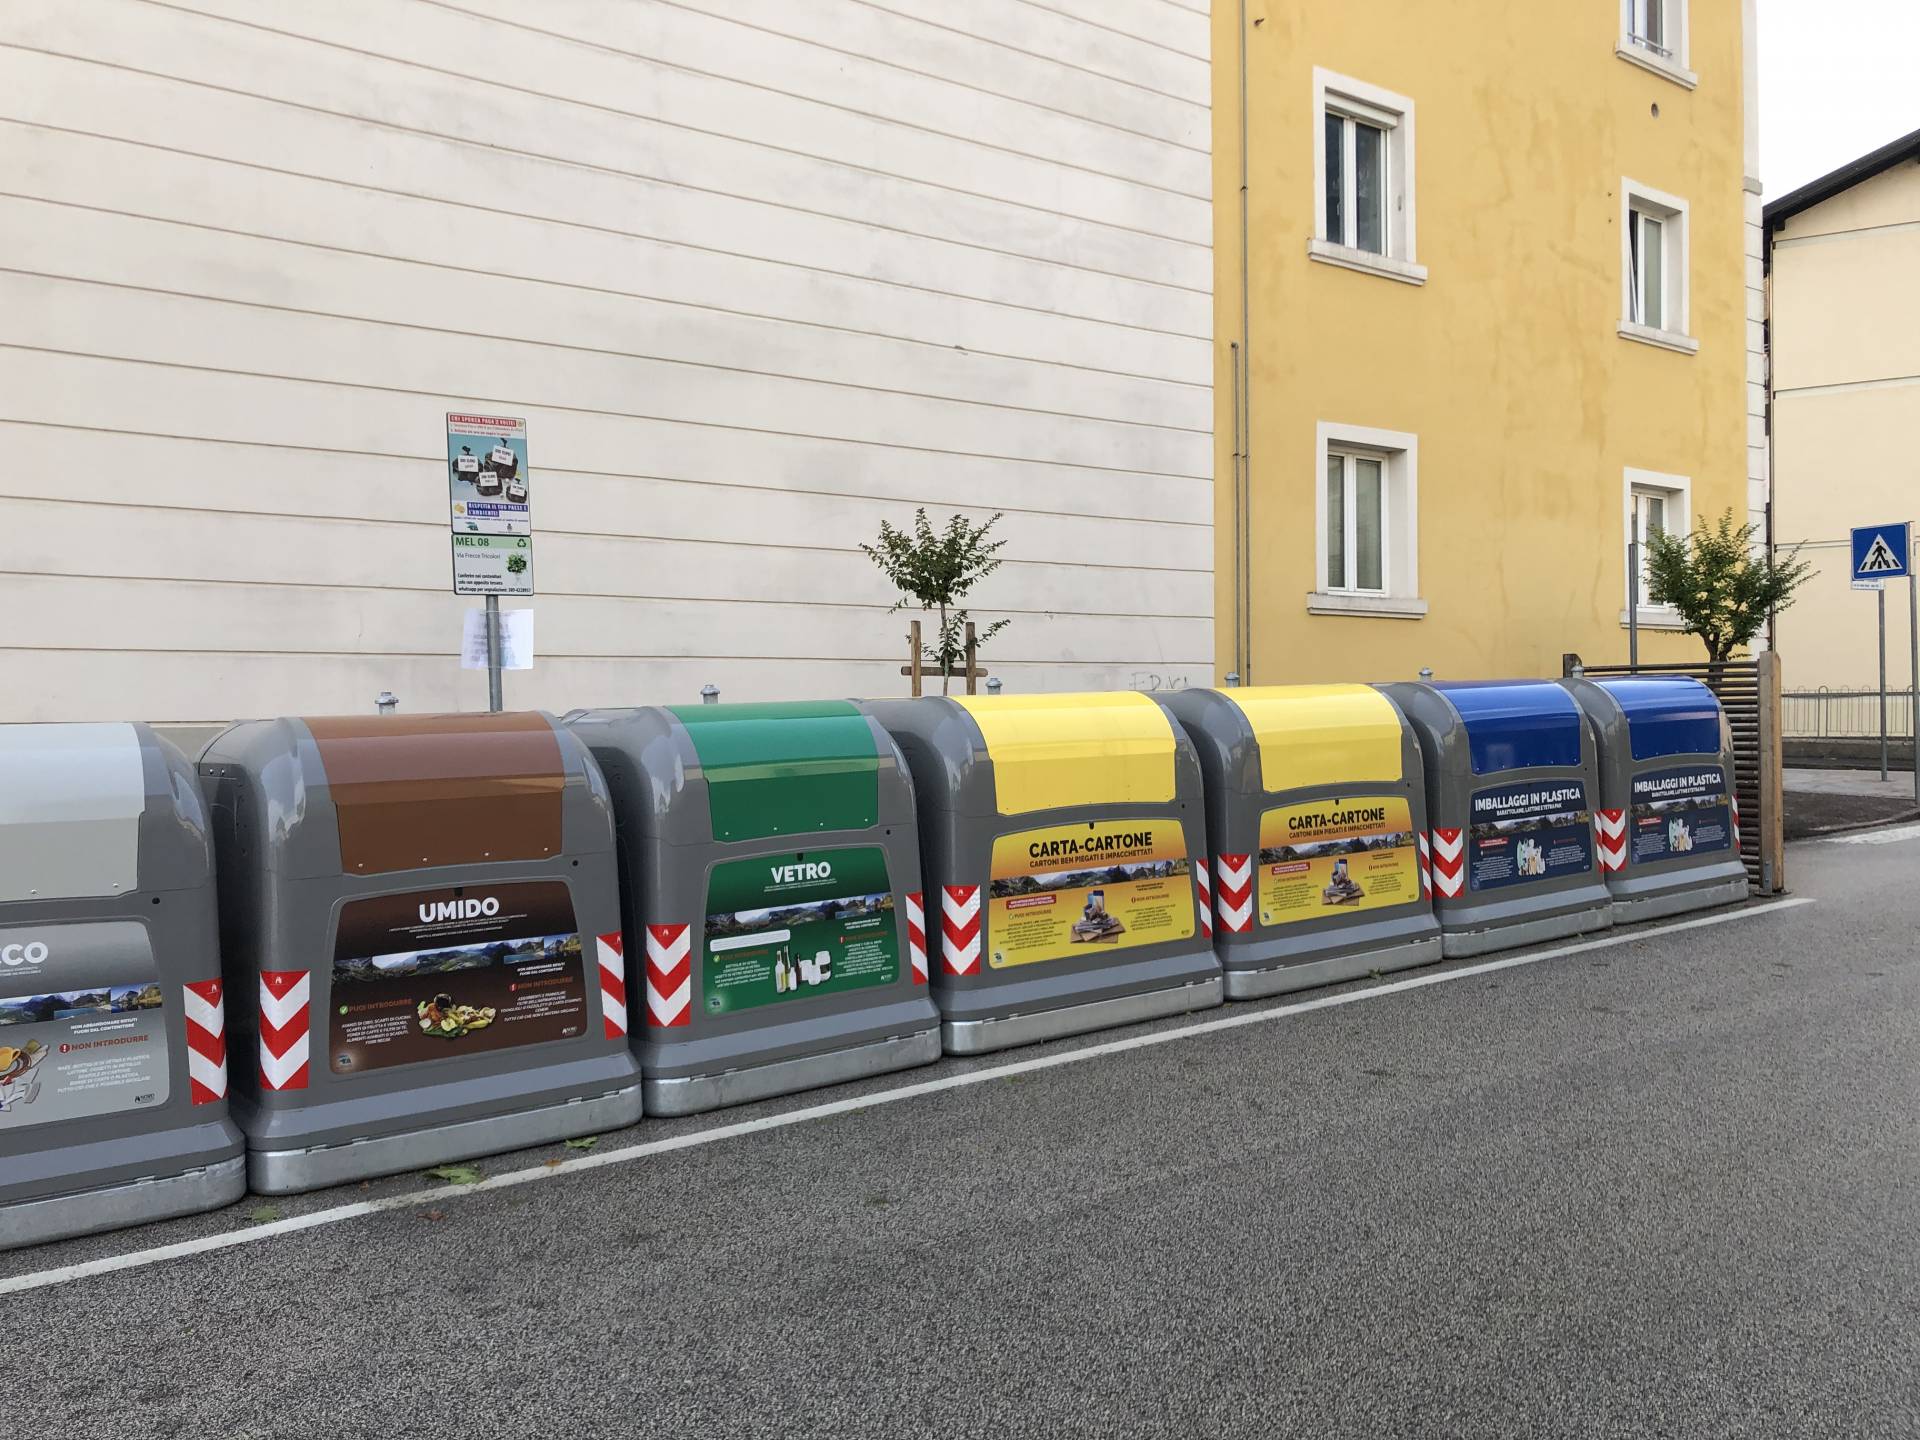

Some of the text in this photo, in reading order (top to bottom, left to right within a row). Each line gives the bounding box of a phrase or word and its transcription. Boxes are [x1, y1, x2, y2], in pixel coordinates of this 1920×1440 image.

[456, 537, 489, 546] MEL 08
[1635, 773, 1721, 792] IMBALLAGGI IN PLASTICA
[1475, 787, 1581, 811] IMBALLAGGI IN PLASTICA
[1288, 807, 1385, 830] CARTA-CARTONE
[1289, 830, 1312, 839] CARTONI
[1313, 829, 1324, 837] BEN
[1324, 827, 1343, 835] PIEGATI
[1348, 822, 1386, 832] IMPACCHETTATI
[1029, 831, 1153, 858] CARTA-CARTONE
[1030, 848, 1153, 868] CARTONI BEN PIEGATI E IMPACCHETTATI
[770, 861, 831, 883] VETRO
[419, 896, 500, 923] UMIDO
[0, 941, 49, 966] CO
[71, 1035, 149, 1051] NON INTRODURRE
